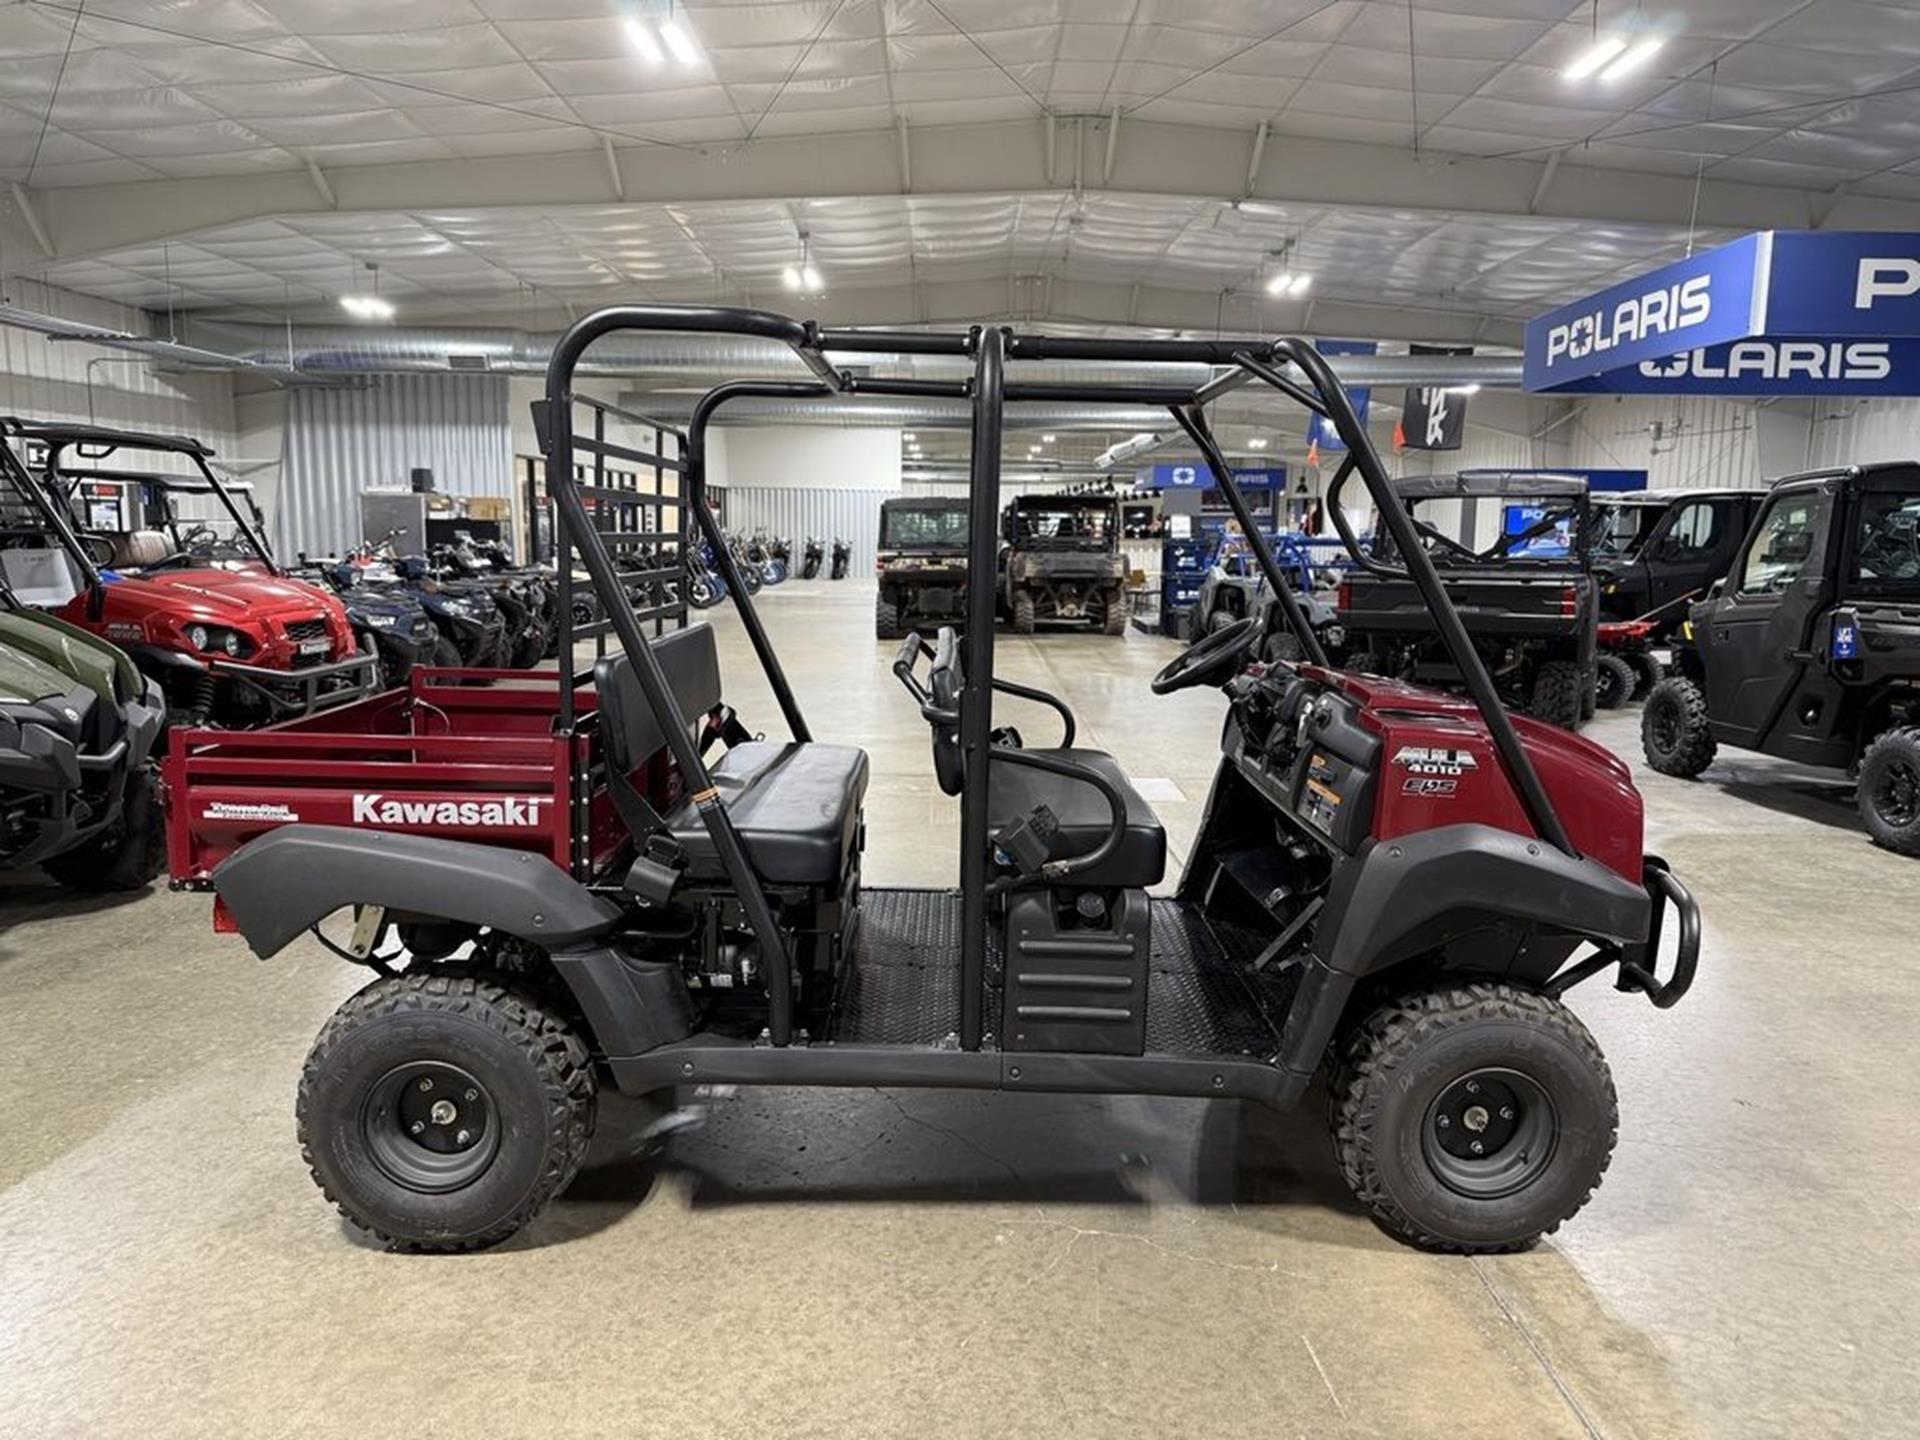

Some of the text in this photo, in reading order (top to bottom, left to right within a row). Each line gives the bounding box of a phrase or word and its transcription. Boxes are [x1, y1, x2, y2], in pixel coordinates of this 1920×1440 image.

[1546, 274, 1711, 367] POLARIS
[1592, 342, 1891, 380] OLARIS
[1407, 764, 1462, 775] 4010
[1402, 778, 1457, 794] EPS
[352, 794, 540, 826] Kawasaki
